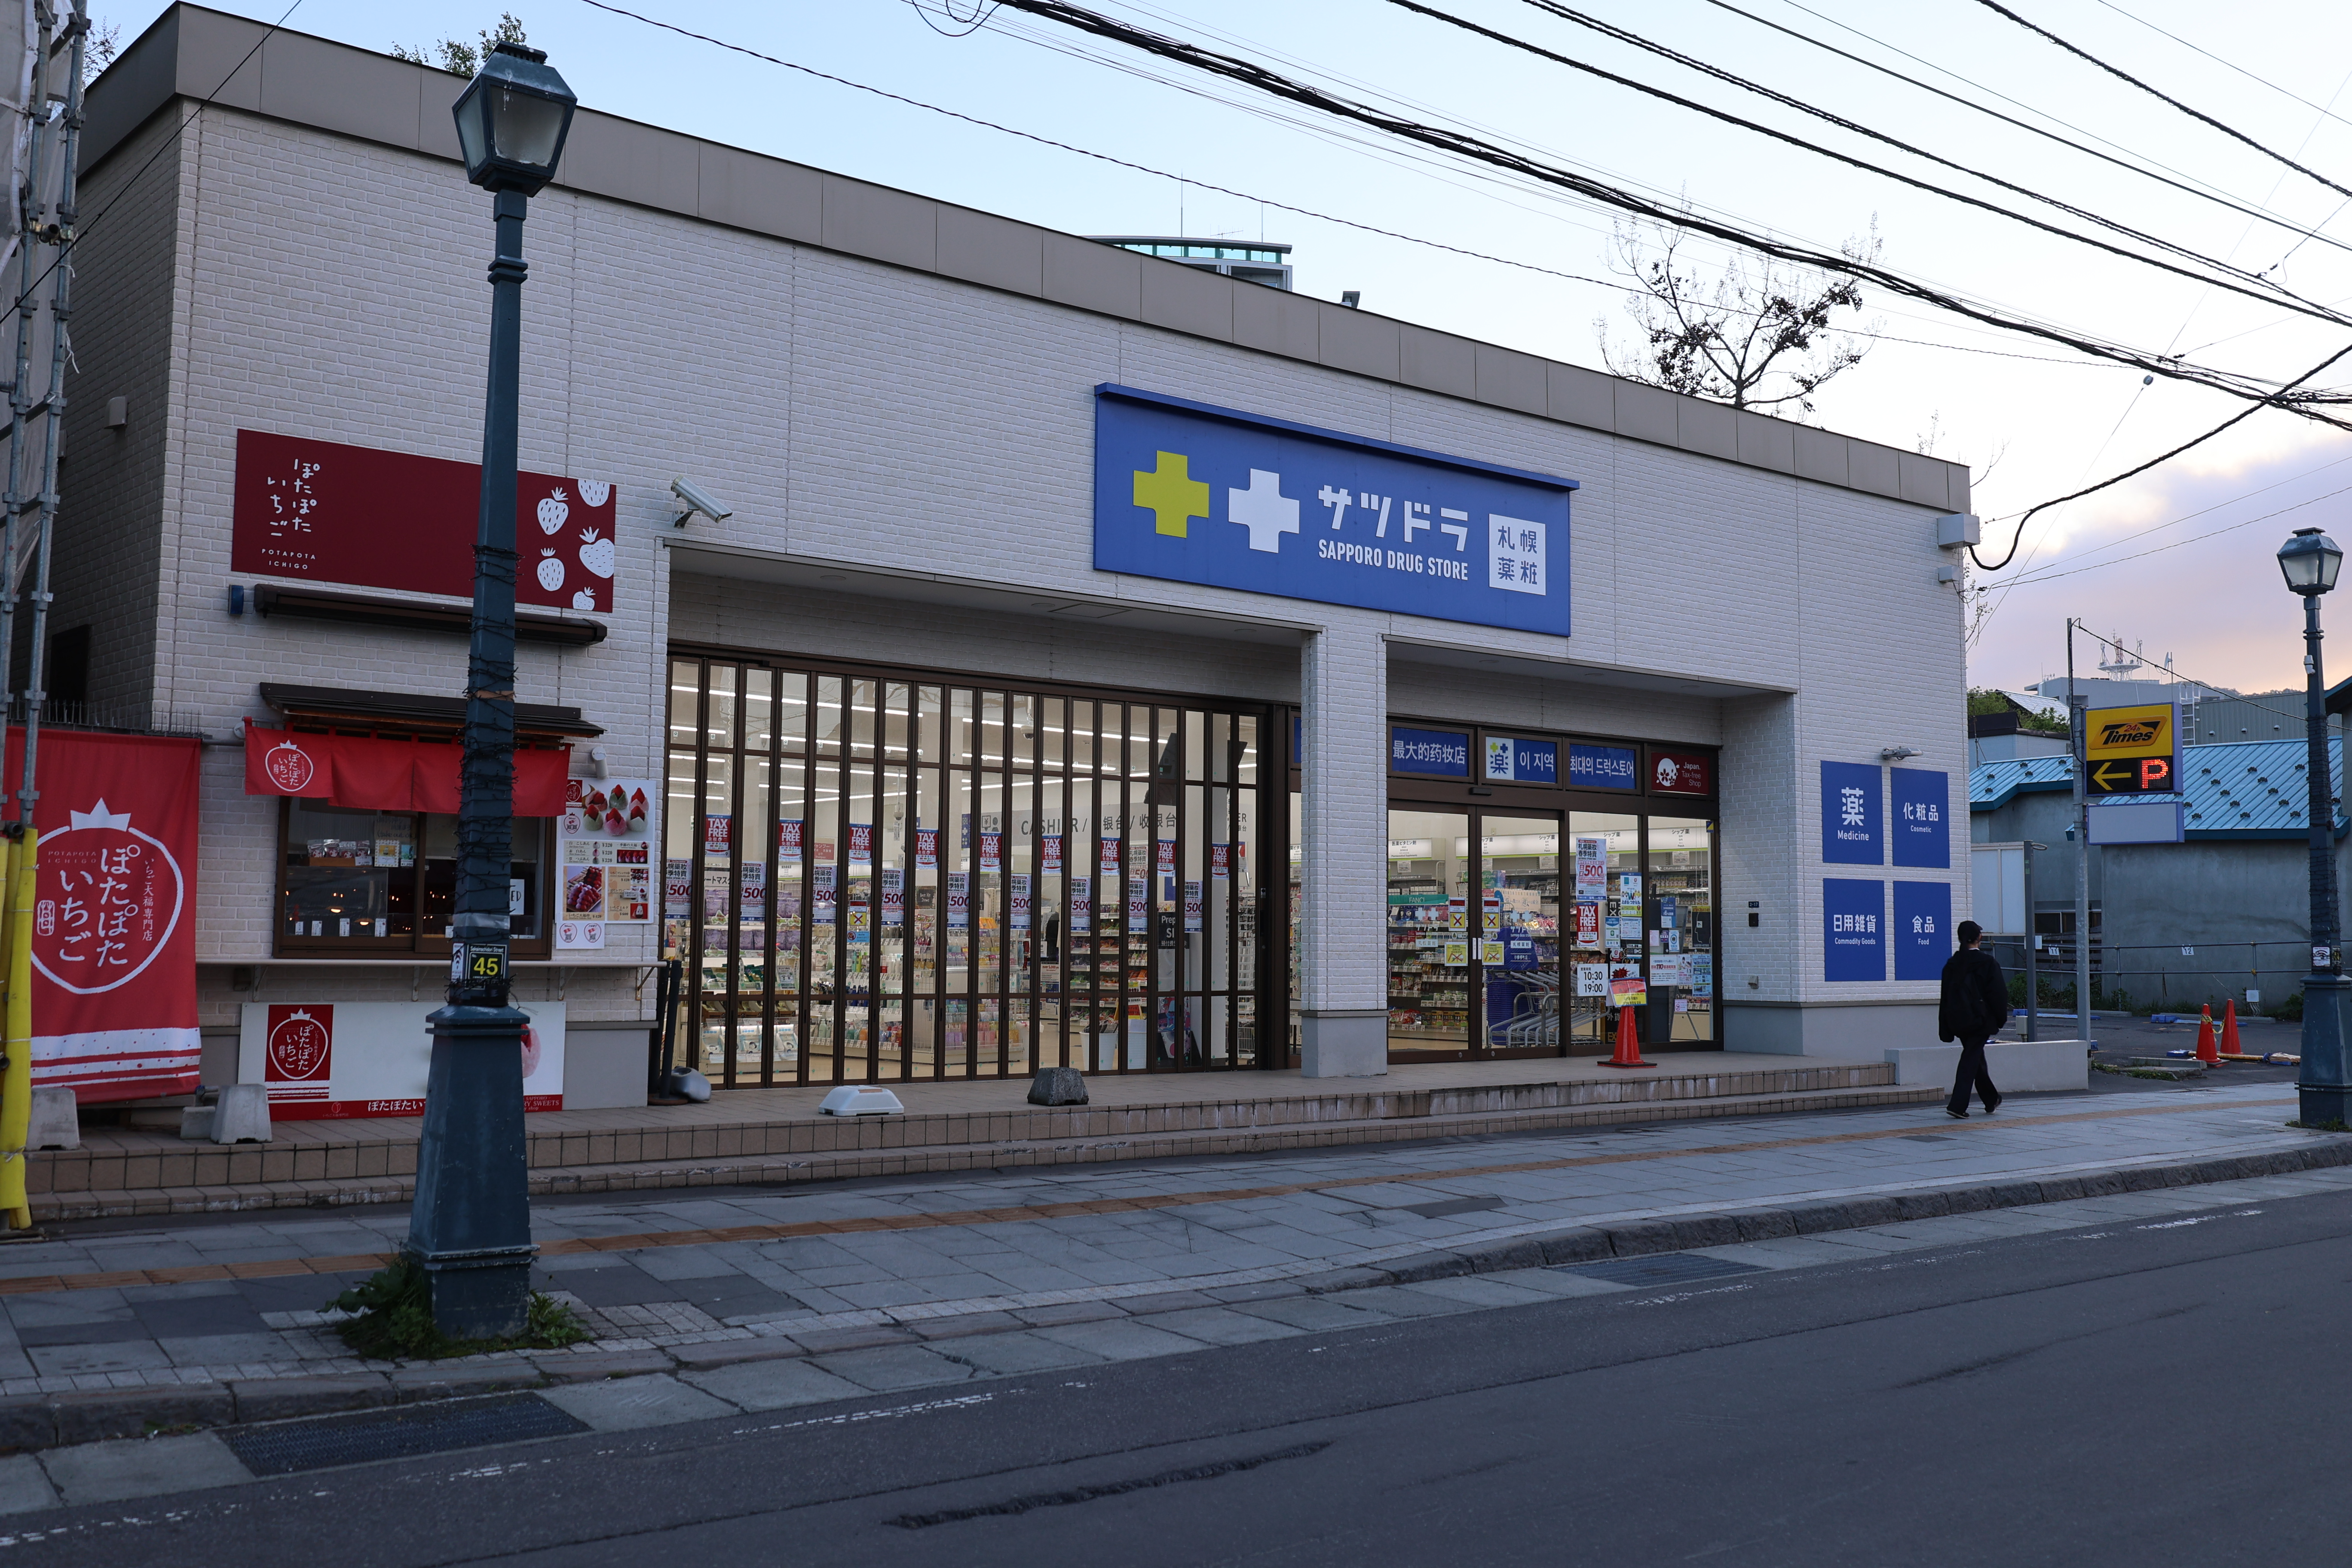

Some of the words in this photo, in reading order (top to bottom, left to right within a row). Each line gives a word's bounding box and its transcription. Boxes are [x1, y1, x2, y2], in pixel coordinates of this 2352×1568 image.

[292, 459, 321, 533] ぽたぽた
[267, 477, 288, 536] いちご
[1318, 484, 1468, 551] サツドラ
[1498, 525, 1537, 554] 札幌
[261, 548, 315, 560] POTAPOTA
[269, 560, 308, 570] ICHIGO
[1318, 539, 1382, 567] SAPPORO
[1387, 550, 1423, 573] DRUG
[1427, 557, 1468, 581] STORE
[1498, 557, 1537, 585] 薬粧
[2124, 724, 2141, 732] 24h
[2102, 730, 2154, 745] Times
[1393, 740, 1466, 765] 最大的药妆店
[1520, 751, 1530, 770] 이
[1534, 752, 1554, 772] 지역
[1570, 756, 1594, 775] 최대의
[1596, 759, 1634, 778] 드럭스토어
[1683, 762, 1701, 771] Japan.
[288, 753, 301, 785] ぽたぽた
[1681, 770, 1701, 779] Tax-free
[2141, 759, 2168, 789] P
[1689, 779, 1701, 788] Shop
[1841, 787, 1864, 826] 薬
[1903, 802, 1939, 821] 化粧品
[708, 818, 728, 829] TAX
[781, 823, 800, 833] TAX
[1021, 818, 1078, 836] CSHIR
[1911, 825, 1932, 833] Cosmetic
[708, 828, 728, 837] FREE
[782, 833, 800, 842] FREE
[851, 827, 870, 837] TAX
[918, 833, 935, 842] TAX
[1838, 830, 1869, 841] Medicine
[851, 837, 870, 846] FREE
[982, 836, 998, 845] TAX
[1044, 839, 1060, 848] TAX
[1102, 841, 1118, 849] TAX
[918, 842, 935, 851] FREE
[982, 845, 998, 853] FREE
[1044, 847, 1060, 855] FREE
[1158, 843, 1173, 851] TAX
[1213, 847, 1227, 855] TAX
[1158, 851, 1173, 859] FREE
[1584, 865, 1604, 877] 500
[704, 876, 730, 884] ートマス
[668, 884, 692, 896] 500
[743, 887, 766, 898] 500
[815, 890, 837, 901] 500
[142, 858, 155, 941] いちご大福専門店
[511, 890, 521, 902] ED
[883, 893, 904, 904] 500
[949, 896, 969, 906] 500
[96, 844, 141, 967] ぽたぽた
[1012, 898, 1032, 908] 500
[1072, 900, 1091, 910] 500
[1130, 902, 1148, 912] 500
[1185, 903, 1203, 912] 500
[59, 870, 93, 961] いちご
[1579, 906, 1596, 917] TAX
[1161, 915, 1176, 925] Prep
[1580, 916, 1596, 926] FREE
[1834, 914, 1876, 933] 日用雑貨
[1912, 915, 1935, 934] 食品
[1834, 937, 1861, 946] Commodity
[1862, 937, 1876, 945] Goods
[474, 957, 498, 975] 45
[1584, 971, 1603, 980] 10:30
[1584, 983, 1603, 993] 19:00
[285, 1035, 297, 1068] いちご
[297, 1024, 314, 1071] ぽたぽた
[368, 1100, 426, 1111] ぽたぽたい
